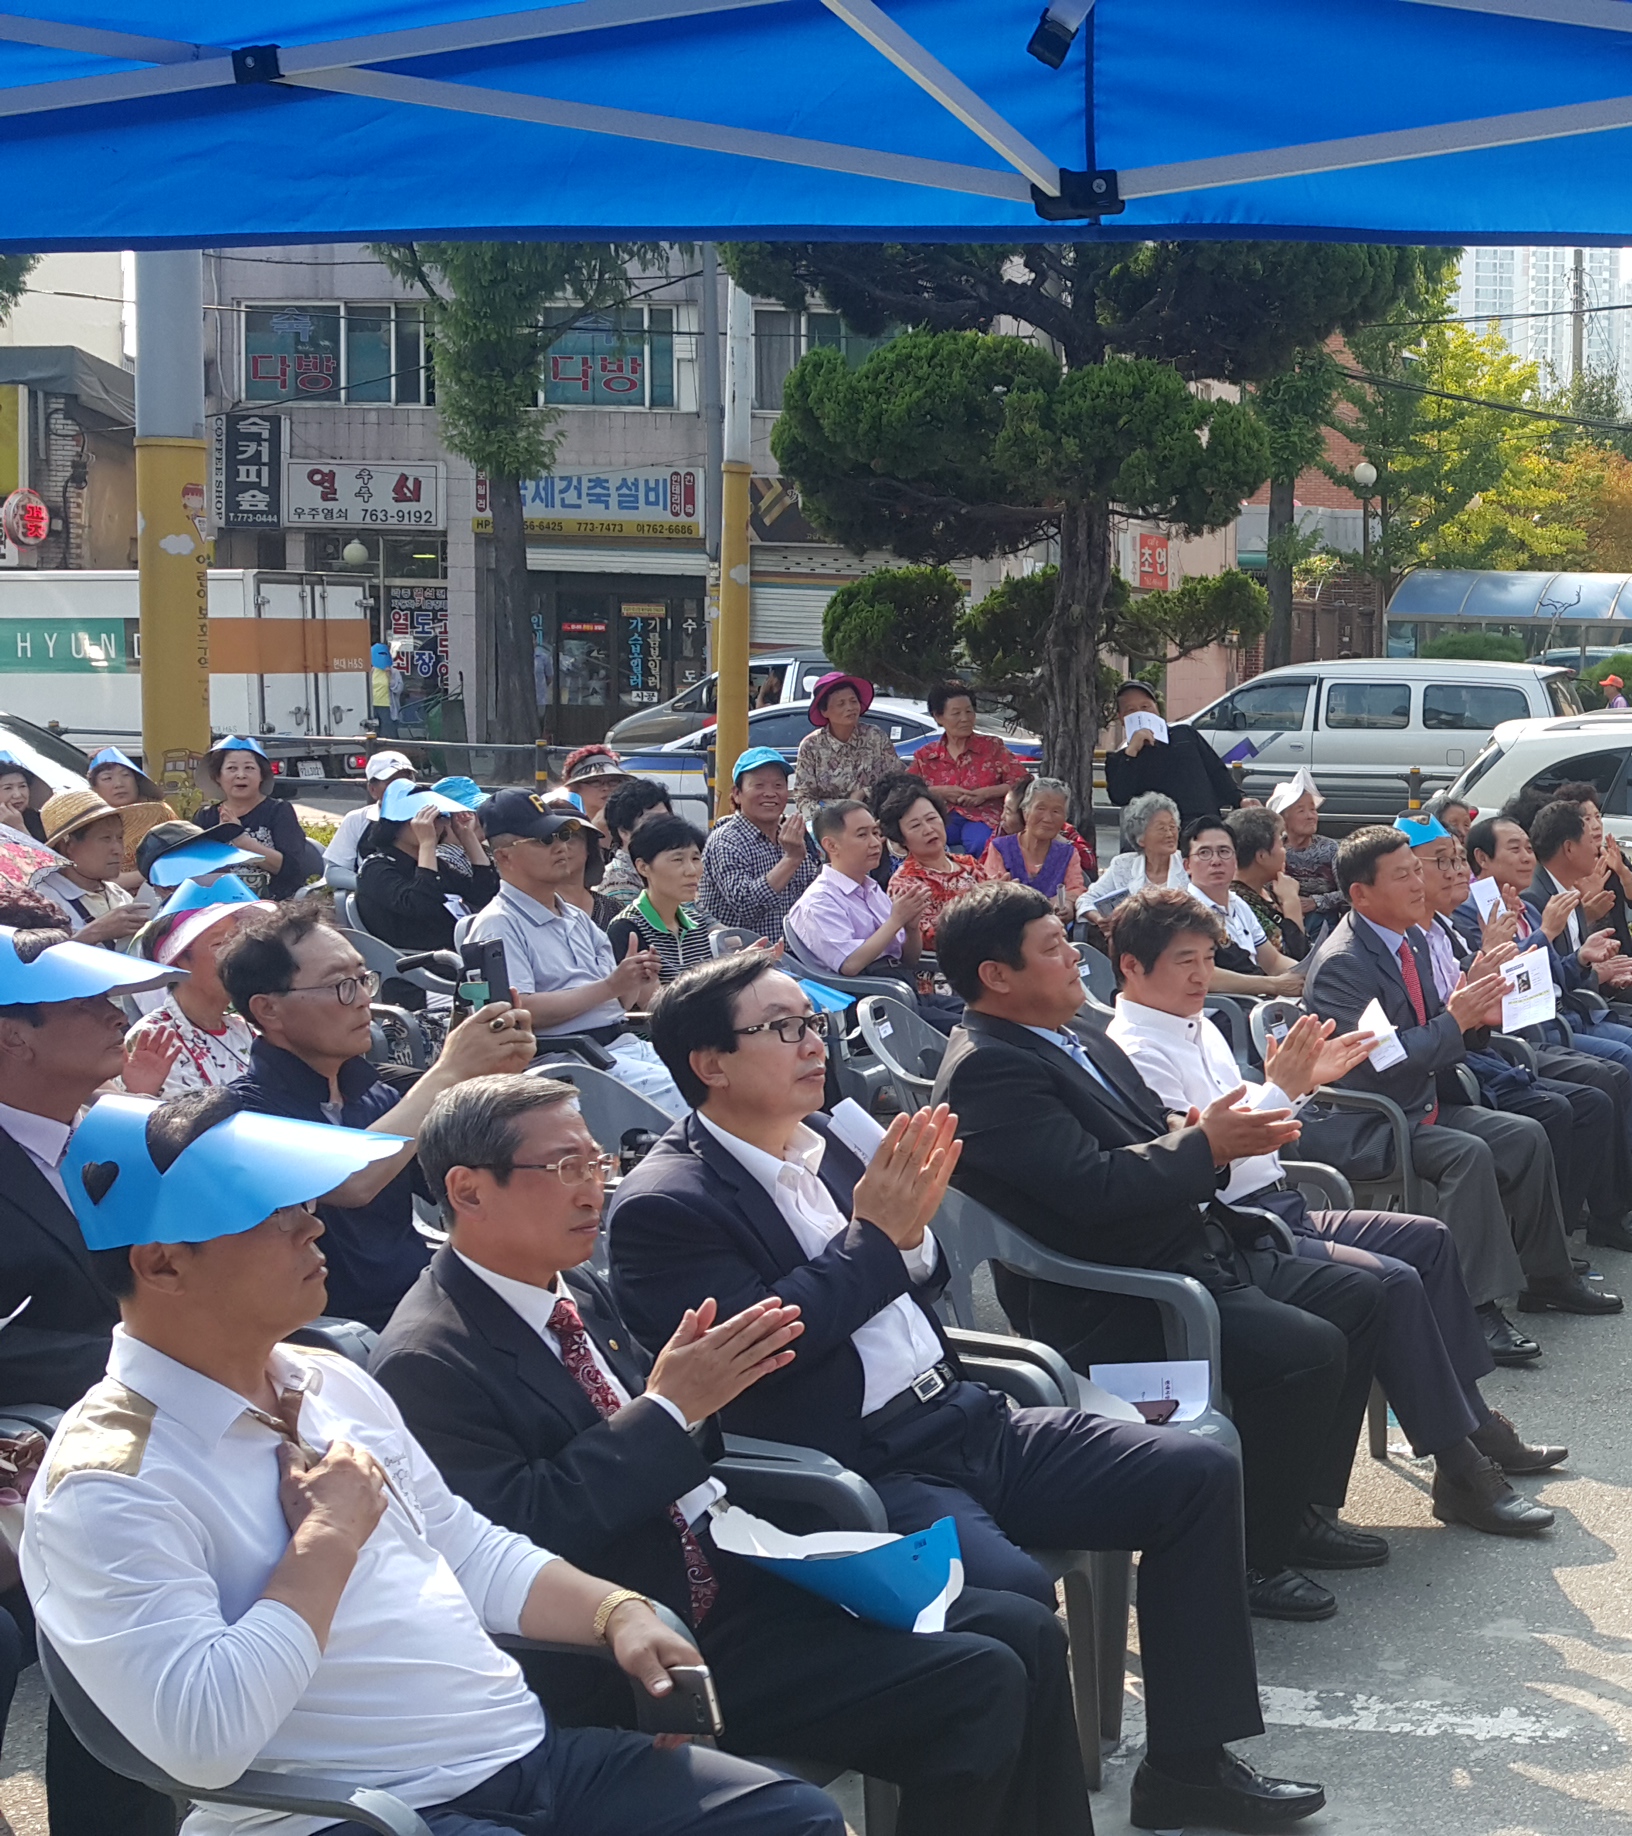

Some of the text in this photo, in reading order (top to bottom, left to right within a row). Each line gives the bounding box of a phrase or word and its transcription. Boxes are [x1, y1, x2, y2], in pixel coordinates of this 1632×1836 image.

[251, 354, 337, 391] 다방
[551, 354, 642, 393] 다방
[214, 417, 224, 521] COFFEE SHOP
[671, 475, 681, 514] 인테리어
[292, 507, 433, 524] 우주열쇠 763-9192
[576, 521, 624, 533] 773-7473
[1140, 546, 1168, 576] 초연
[347, 657, 363, 669] H&S
[628, 617, 643, 689] 가스보일러
[647, 617, 661, 689] 기름보일러
[529, 793, 545, 813] P
